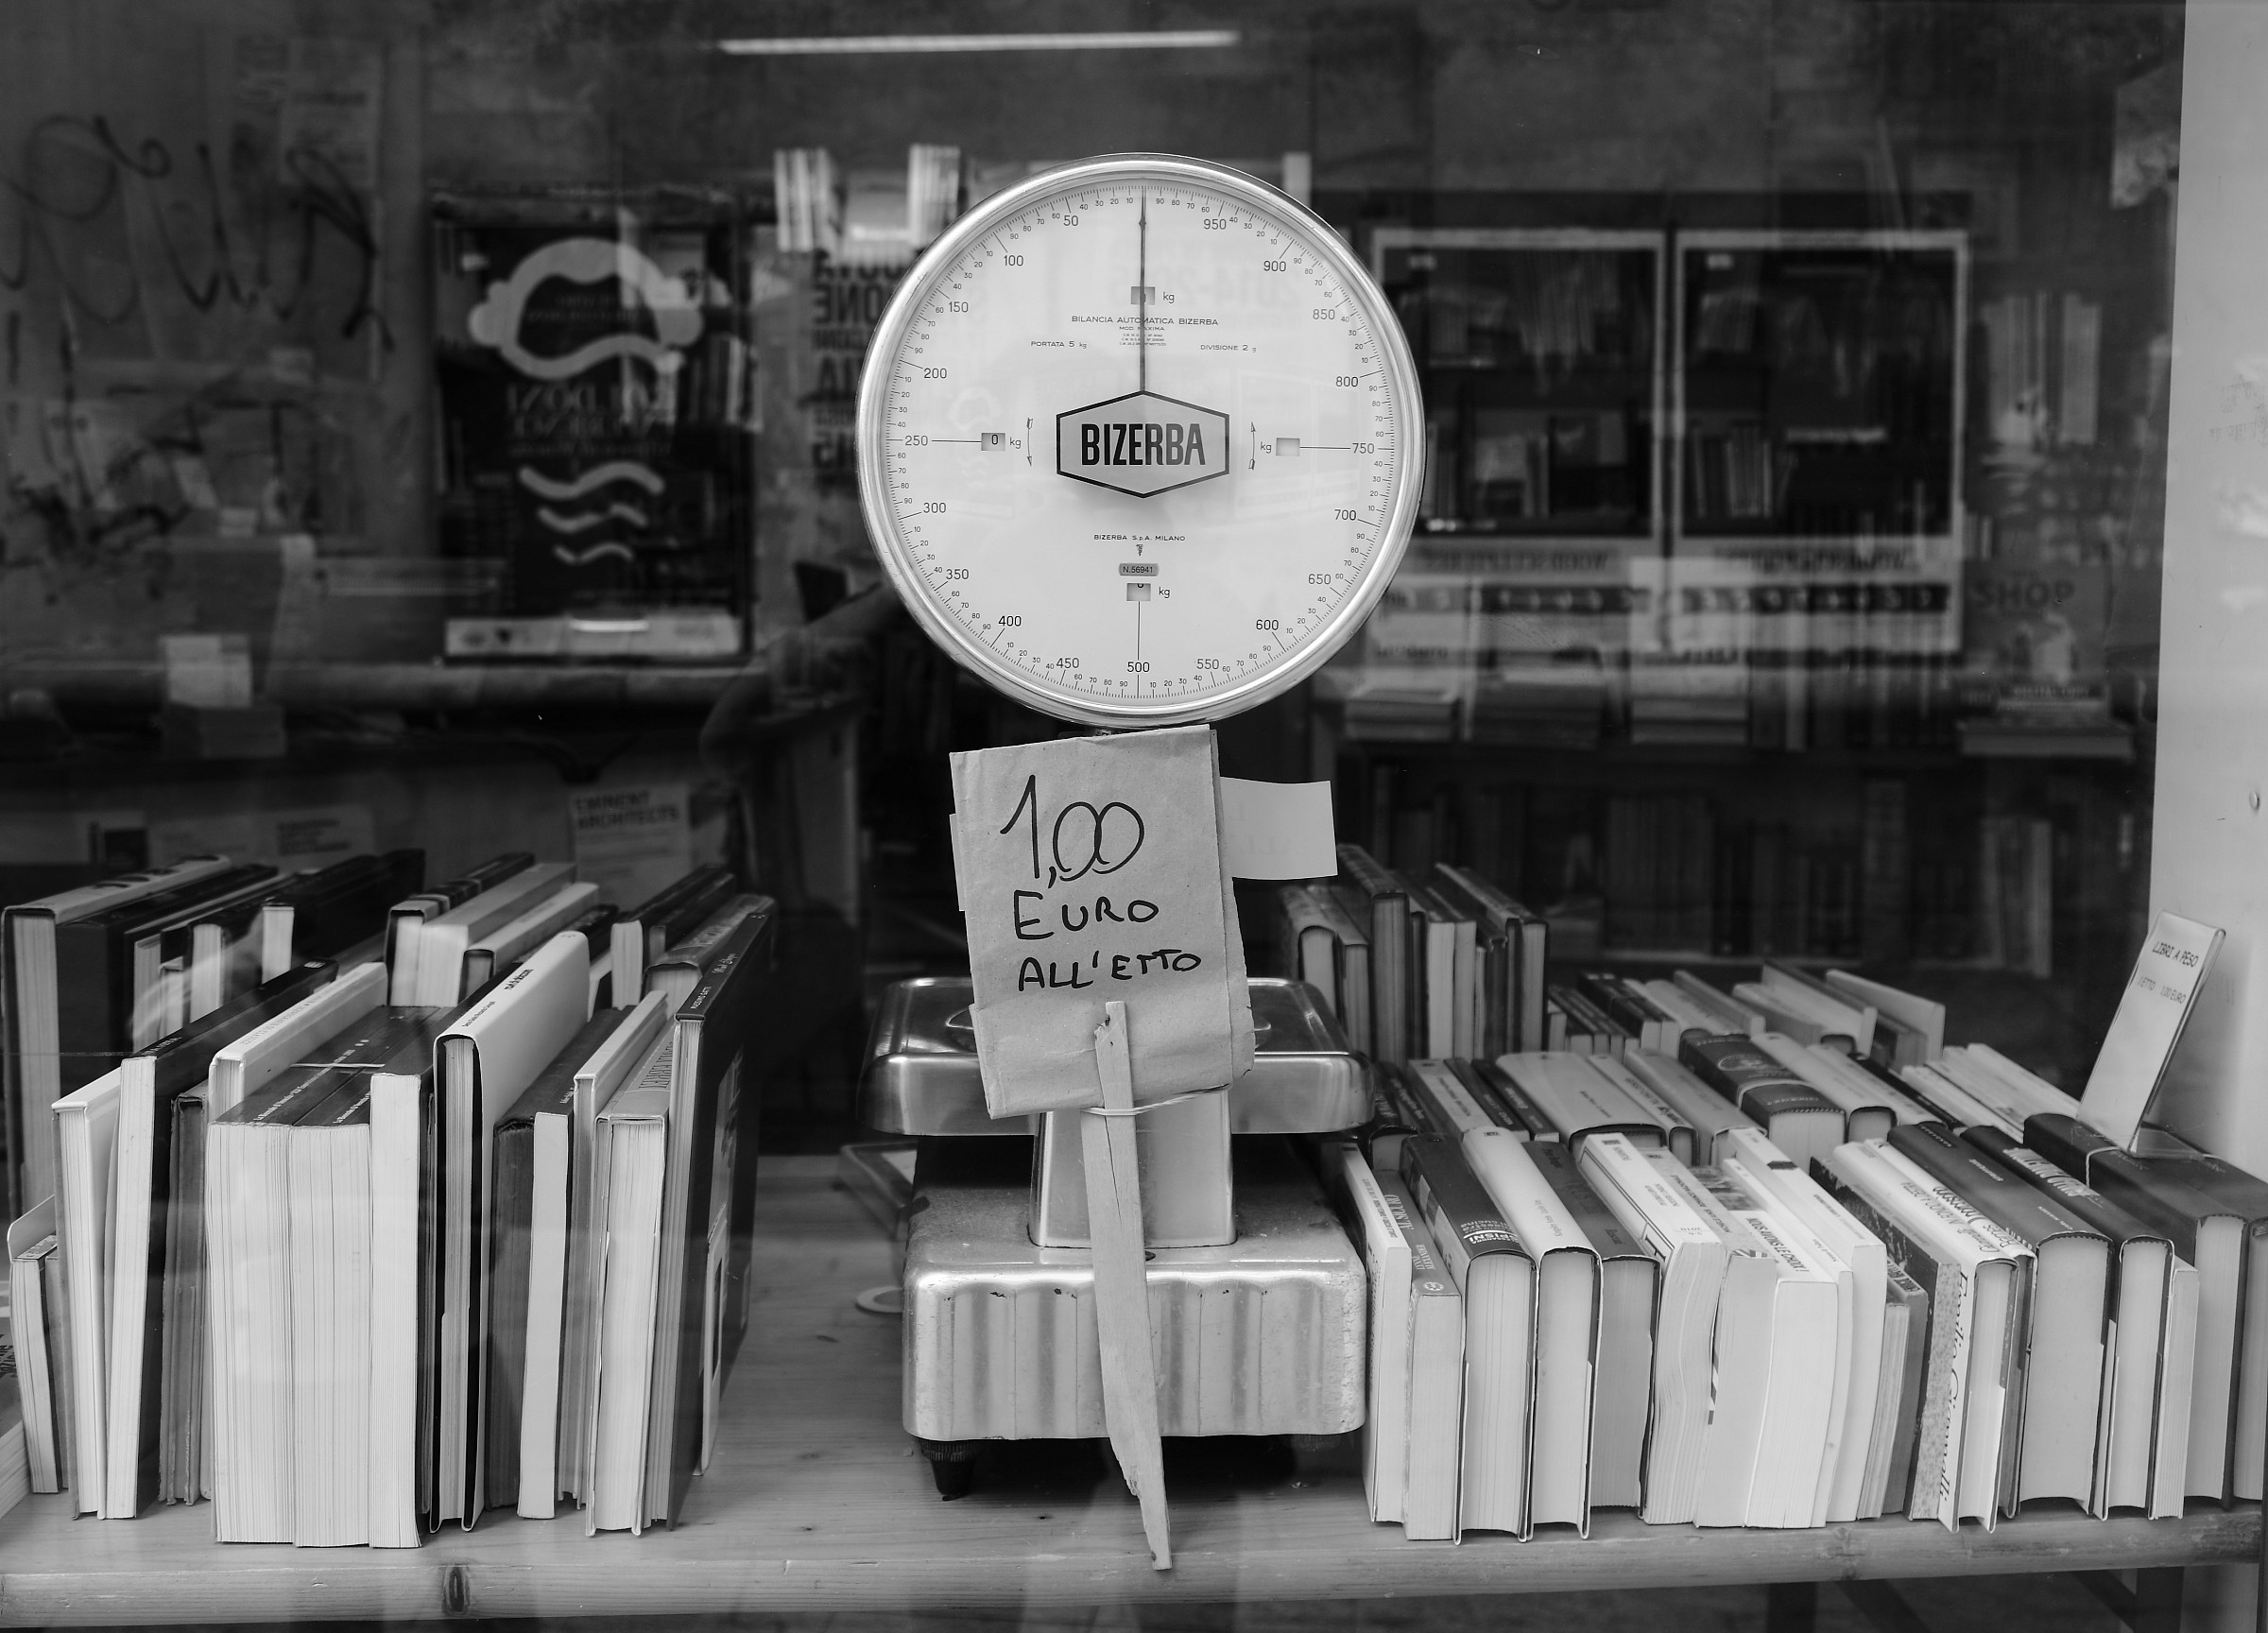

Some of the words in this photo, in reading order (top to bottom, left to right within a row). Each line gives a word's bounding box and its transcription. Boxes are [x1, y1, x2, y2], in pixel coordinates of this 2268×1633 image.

[1156, 197, 1165, 205] 90
[1171, 198, 1180, 207] 80
[1051, 212, 1060, 220] 60
[1063, 215, 1079, 227] 50
[1203, 219, 1227, 231] 950
[1004, 255, 1024, 266] 100
[1263, 261, 1287, 272] 900
[1314, 279, 1323, 287] 70
[1162, 291, 1175, 304] kg
[1323, 290, 1332, 299] 60
[949, 301, 969, 314] 150
[1072, 315, 1113, 323] BILANCIA
[1313, 309, 1335, 320] 850
[1340, 315, 1349, 323] 40
[927, 319, 936, 328] 70
[920, 333, 930, 341] 80
[1354, 342, 1364, 351] 20
[923, 368, 947, 379] 200
[1335, 376, 1359, 387] 800
[901, 390, 910, 399] 20
[1375, 430, 1384, 438] 60
[904, 435, 928, 446] 250
[1009, 437, 1022, 449] kg
[1081, 423, 1206, 466] BIZERBA
[1260, 441, 1272, 454] kg
[1351, 442, 1375, 455] 750
[1372, 475, 1382, 484] 30
[1369, 490, 1379, 498] 20
[922, 502, 947, 514] 300
[1334, 509, 1357, 521] 700
[1356, 532, 1366, 541] 90
[919, 539, 929, 547] 20
[945, 569, 970, 580] 350
[1308, 574, 1332, 585] 650
[1159, 587, 1171, 598] kg
[1317, 595, 1327, 604] 40
[960, 601, 970, 610] 70
[998, 615, 1022, 627] 400
[1255, 620, 1280, 631] 600
[1286, 627, 1294, 635] 10
[1032, 656, 1041, 664] 30
[1248, 652, 1258, 661] 80
[1056, 658, 1080, 669] 450
[1126, 662, 1150, 673] 500
[1196, 659, 1219, 670] 550
[1089, 676, 1098, 684] 70
[1000, 775, 1144, 888] 1,00
[1013, 889, 1160, 940] EURO
[2152, 941, 2174, 958] LIBRI
[2173, 950, 2181, 961] A
[2179, 951, 2199, 968] PESO
[1018, 949, 1202, 991] ALL'ETTO
